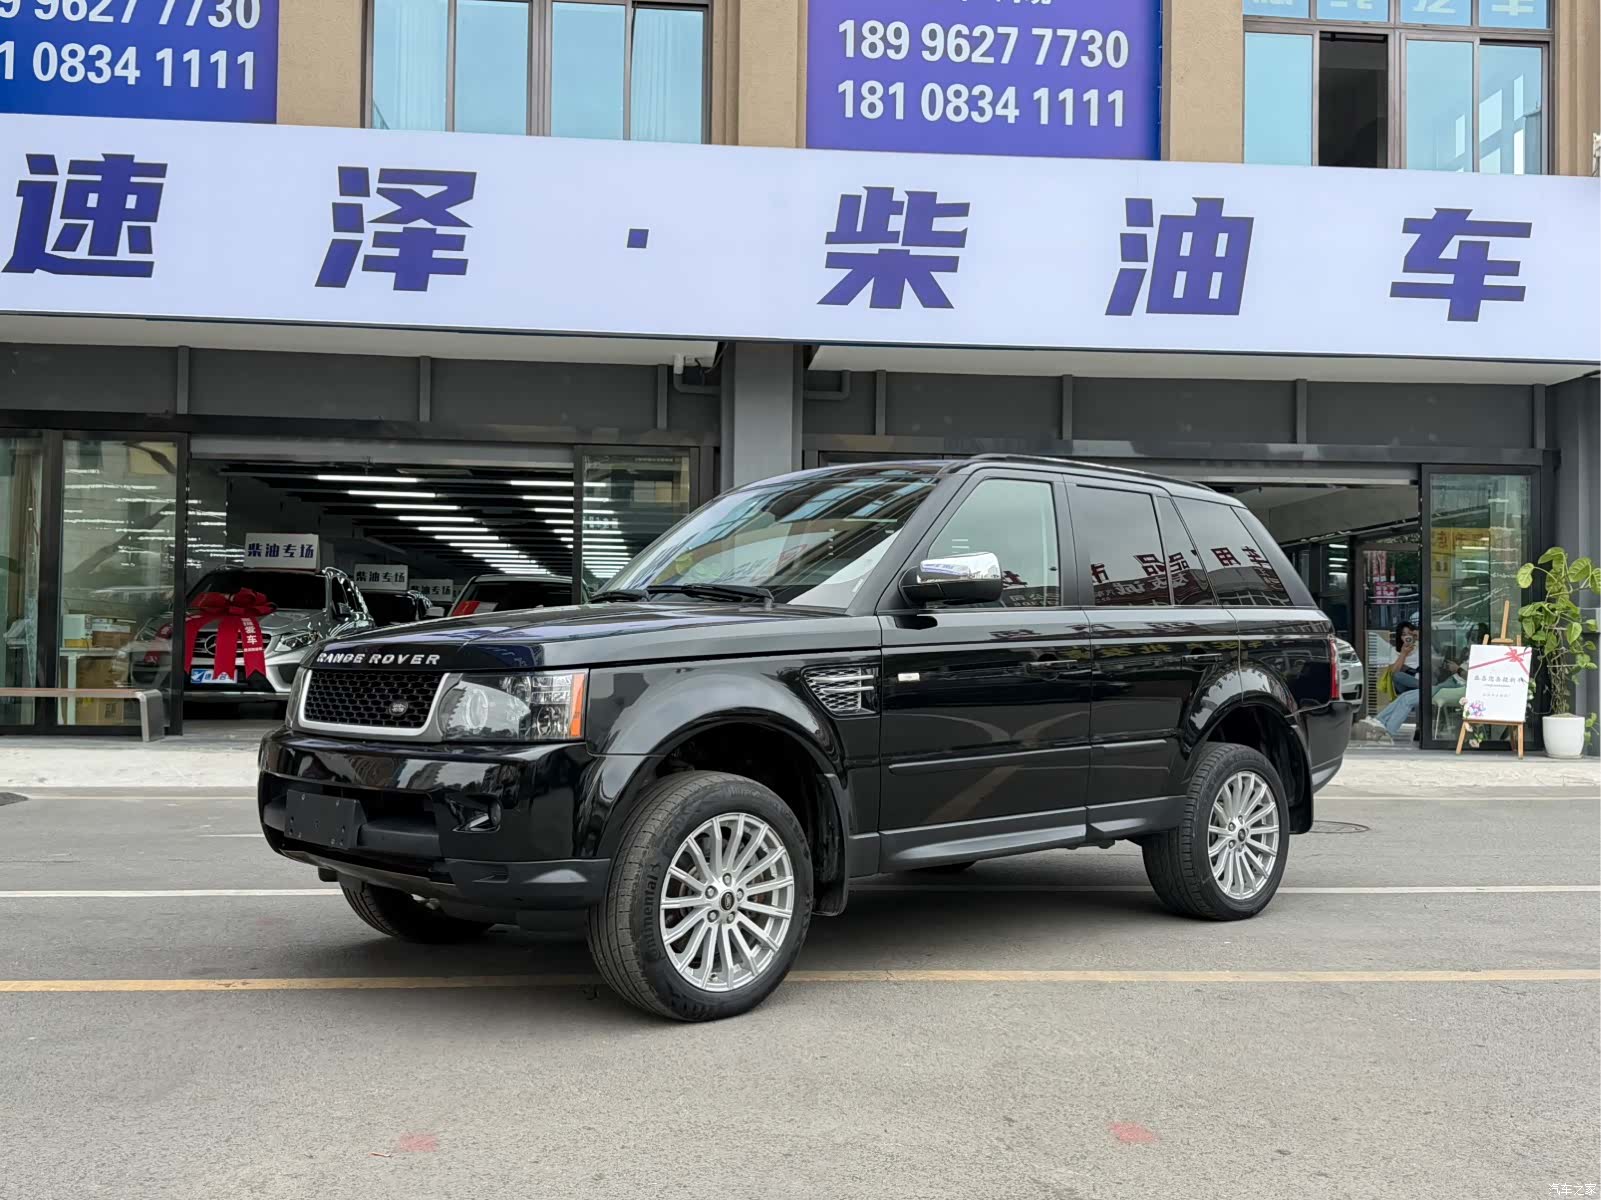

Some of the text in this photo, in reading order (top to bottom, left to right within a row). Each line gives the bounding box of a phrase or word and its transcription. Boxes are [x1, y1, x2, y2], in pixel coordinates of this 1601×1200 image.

[158, 0, 261, 29] 7730
[838, 19, 1129, 68] 189 9627 7730
[32, 41, 141, 85] 0834
[155, 47, 255, 90] 1111
[837, 79, 1124, 127] 181 0834 1111
[247, 543, 315, 558] 柴油专场
[355, 570, 406, 583] 柴油专场
[316, 652, 441, 666] RANGE ROVER
